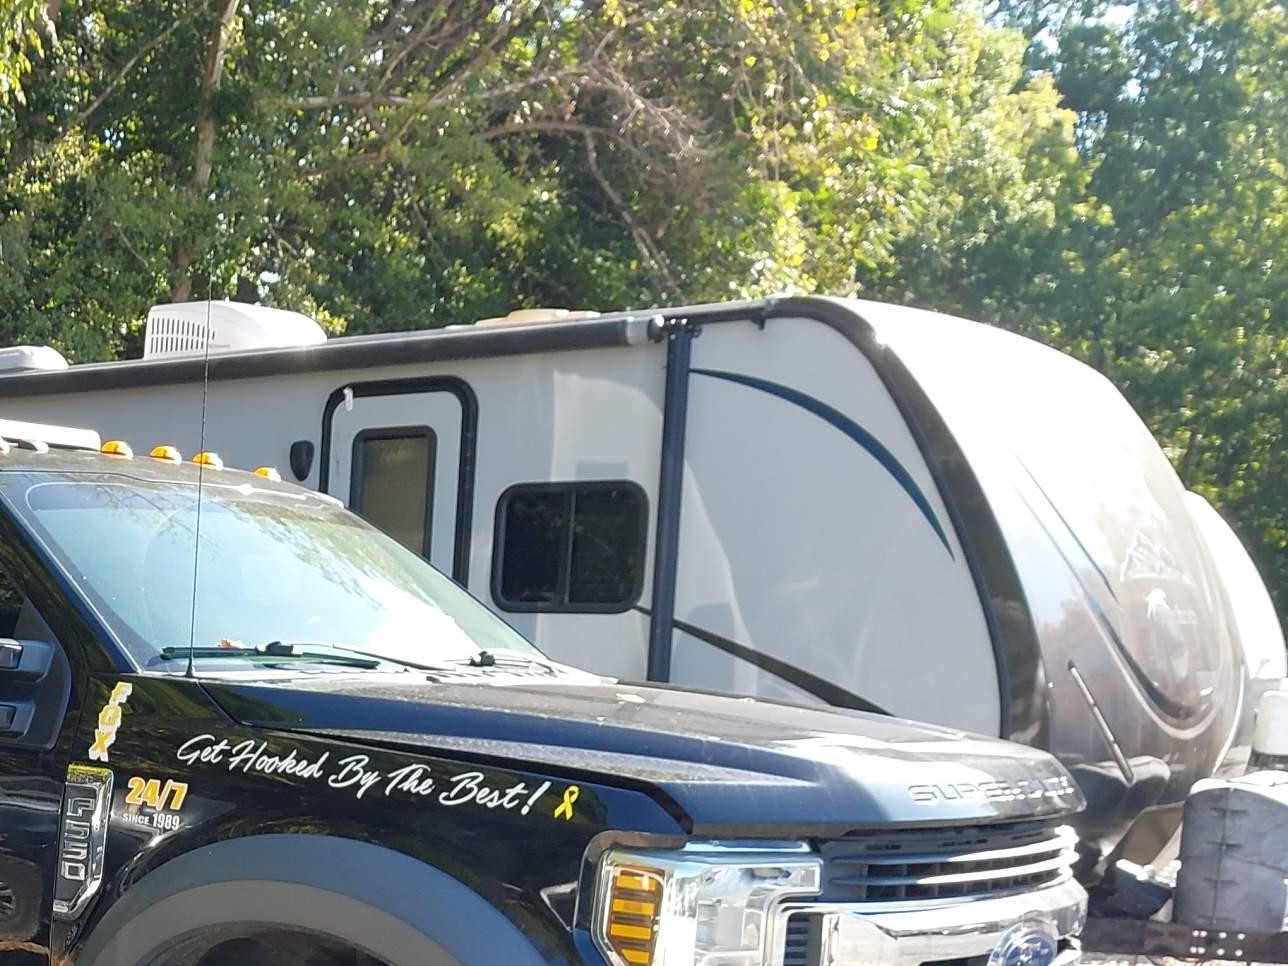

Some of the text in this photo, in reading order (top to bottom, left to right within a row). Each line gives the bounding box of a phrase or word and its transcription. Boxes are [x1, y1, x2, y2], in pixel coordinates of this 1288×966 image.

[177, 734, 552, 816] Get Hooked By The Best!
[125, 776, 188, 811] 24/7
[122, 813, 180, 830] SINCE 1989
